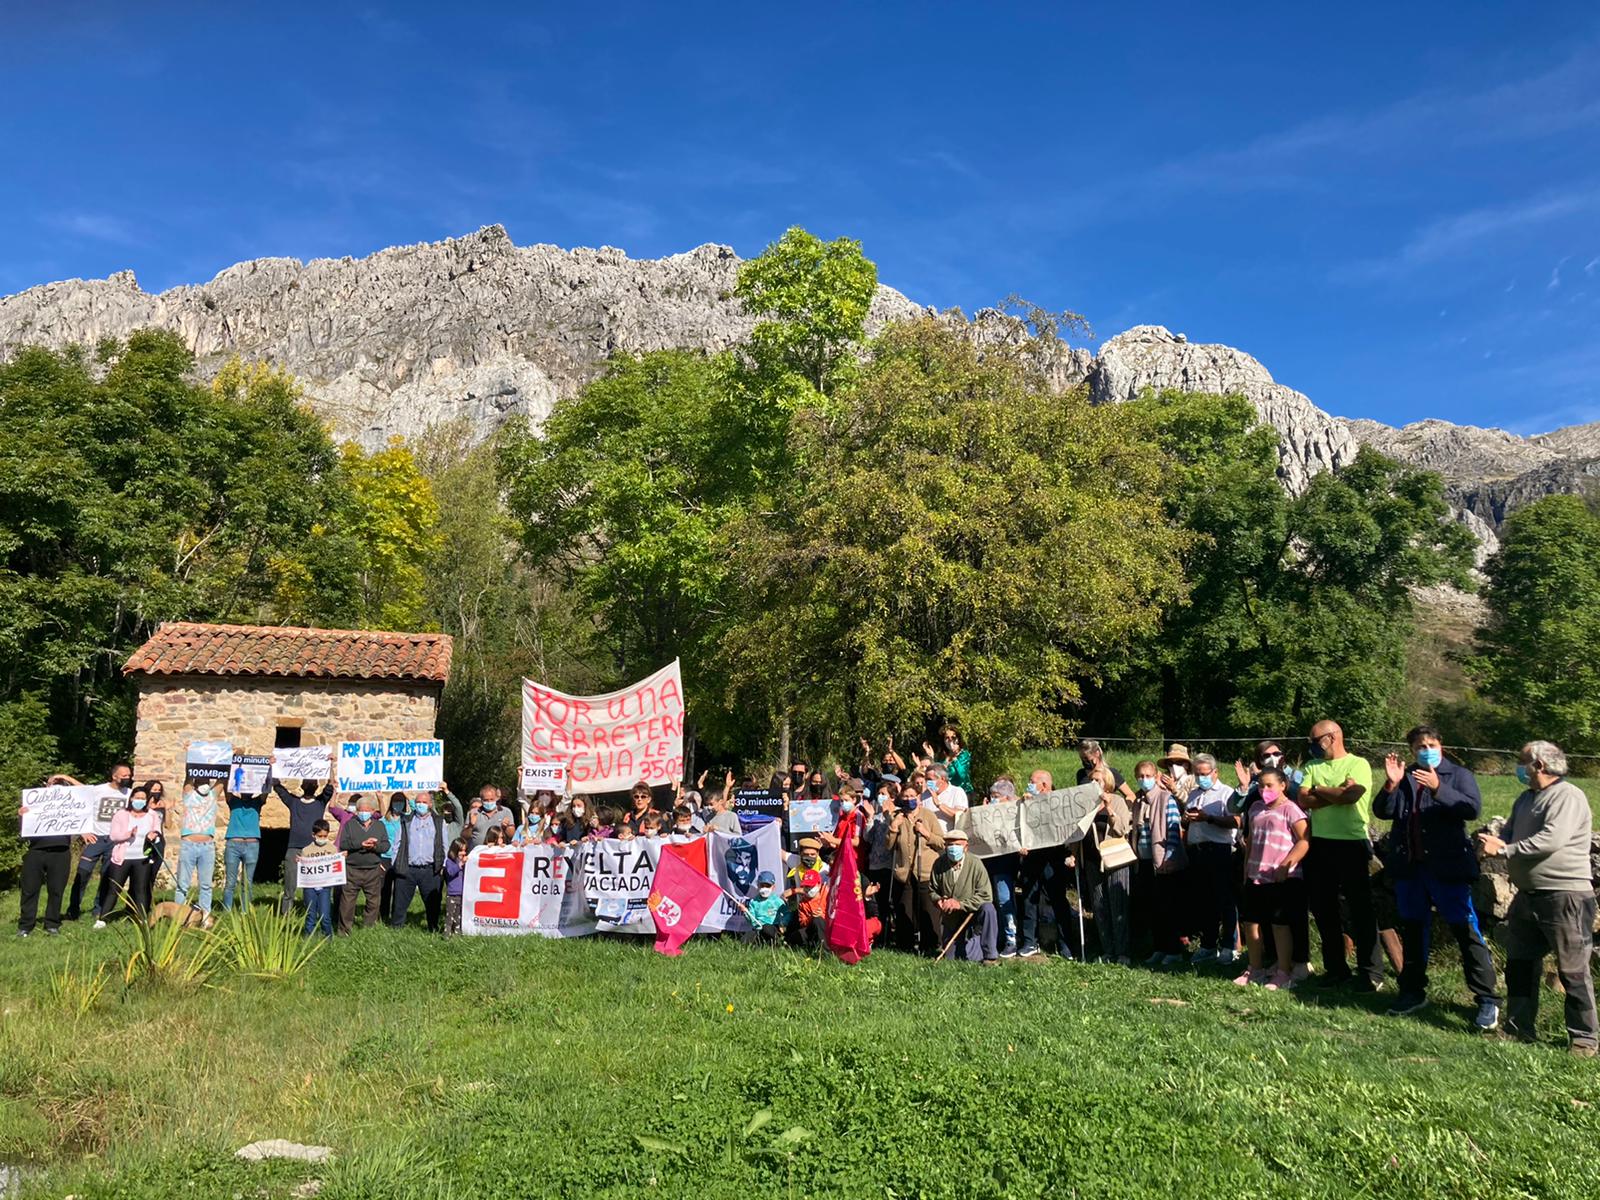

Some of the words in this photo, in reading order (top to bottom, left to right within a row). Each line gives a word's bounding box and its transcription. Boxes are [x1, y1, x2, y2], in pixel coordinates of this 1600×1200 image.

[529, 687, 592, 725] POR
[608, 679, 682, 721] UNA
[342, 742, 361, 758] POR
[363, 742, 384, 758] UNA
[387, 741, 441, 757] CARRETERA
[644, 741, 671, 758] LE
[244, 755, 270, 764] minuto
[188, 769, 229, 779] 100MBps
[735, 798, 747, 807] 30
[748, 797, 783, 806] minutos
[532, 880, 548, 895] de
[550, 882, 560, 895] la
